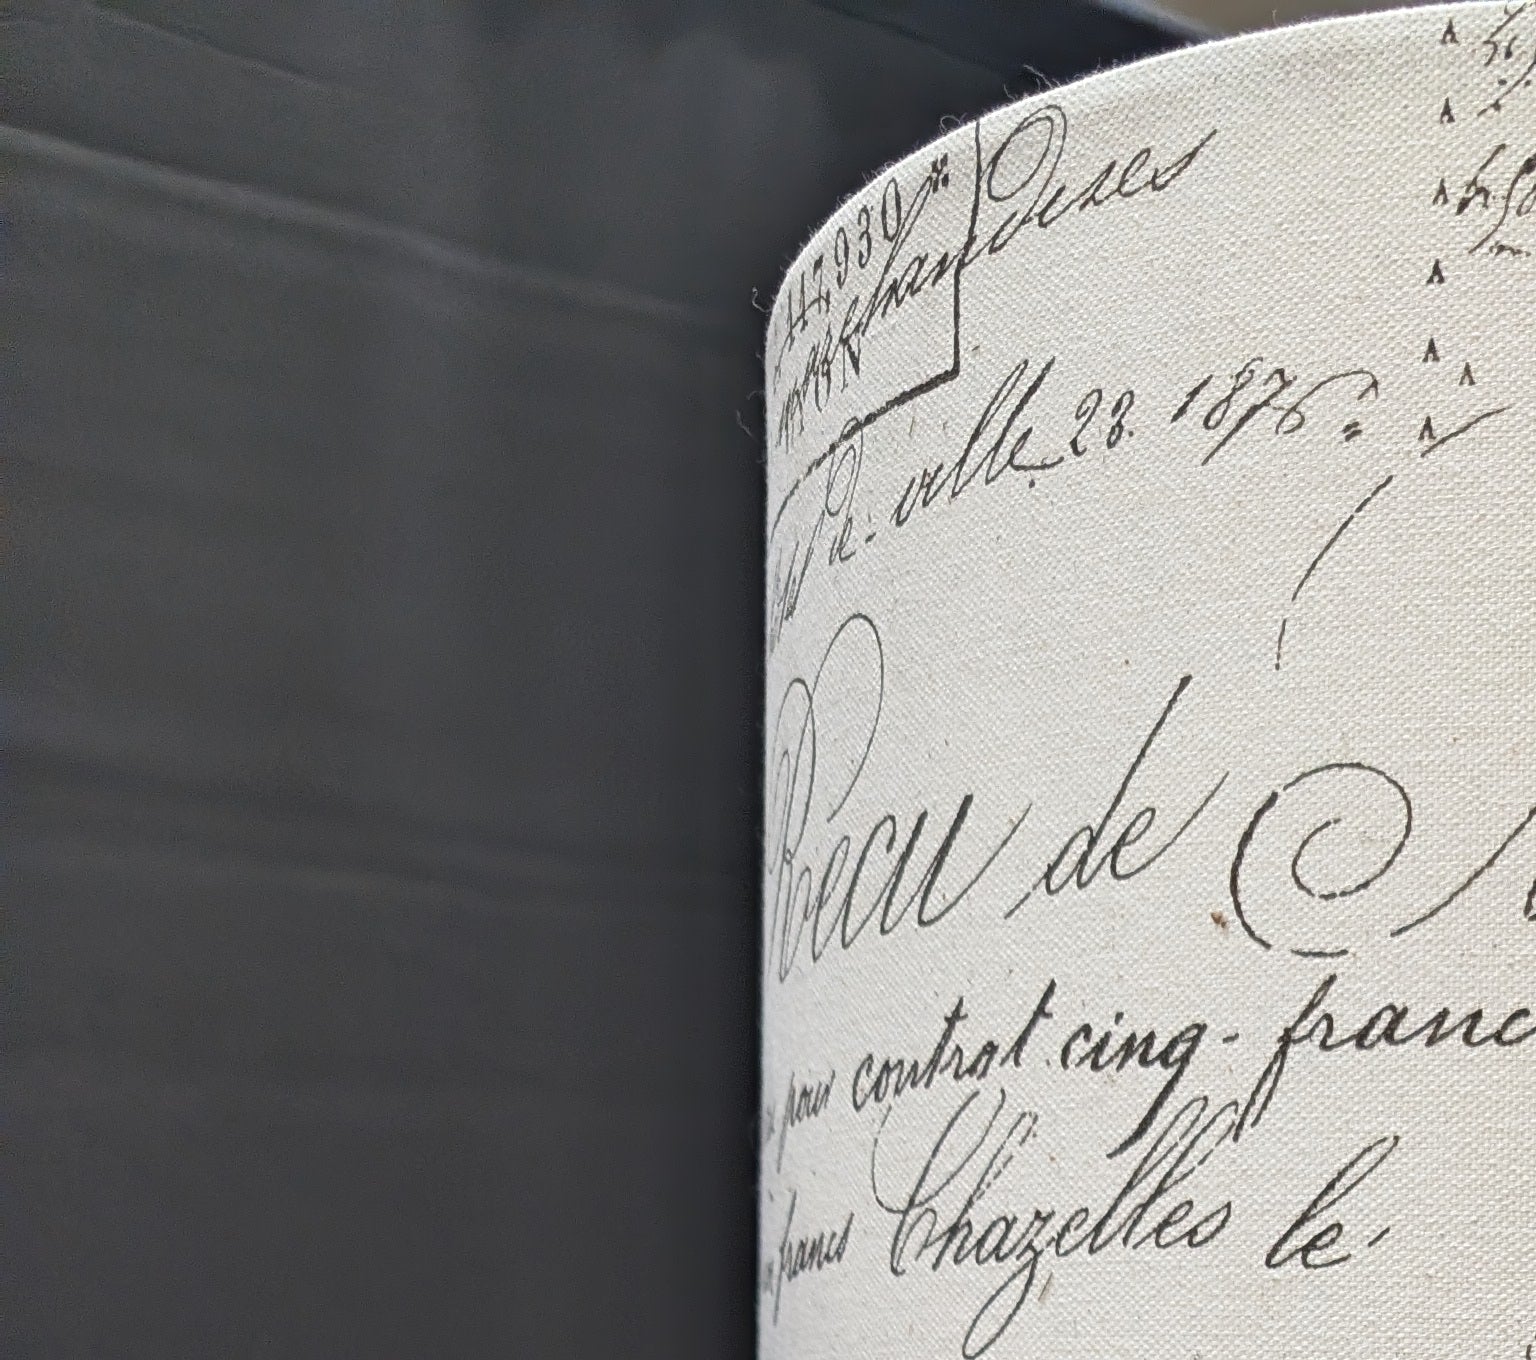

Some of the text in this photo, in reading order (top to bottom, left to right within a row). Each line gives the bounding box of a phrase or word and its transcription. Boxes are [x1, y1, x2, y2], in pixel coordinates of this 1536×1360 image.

[1441, 18, 1459, 44] A
[1439, 98, 1455, 123] A
[1434, 178, 1449, 204] A
[1426, 258, 1445, 285] A
[1422, 337, 1440, 362] A
[1418, 415, 1436, 440] A
